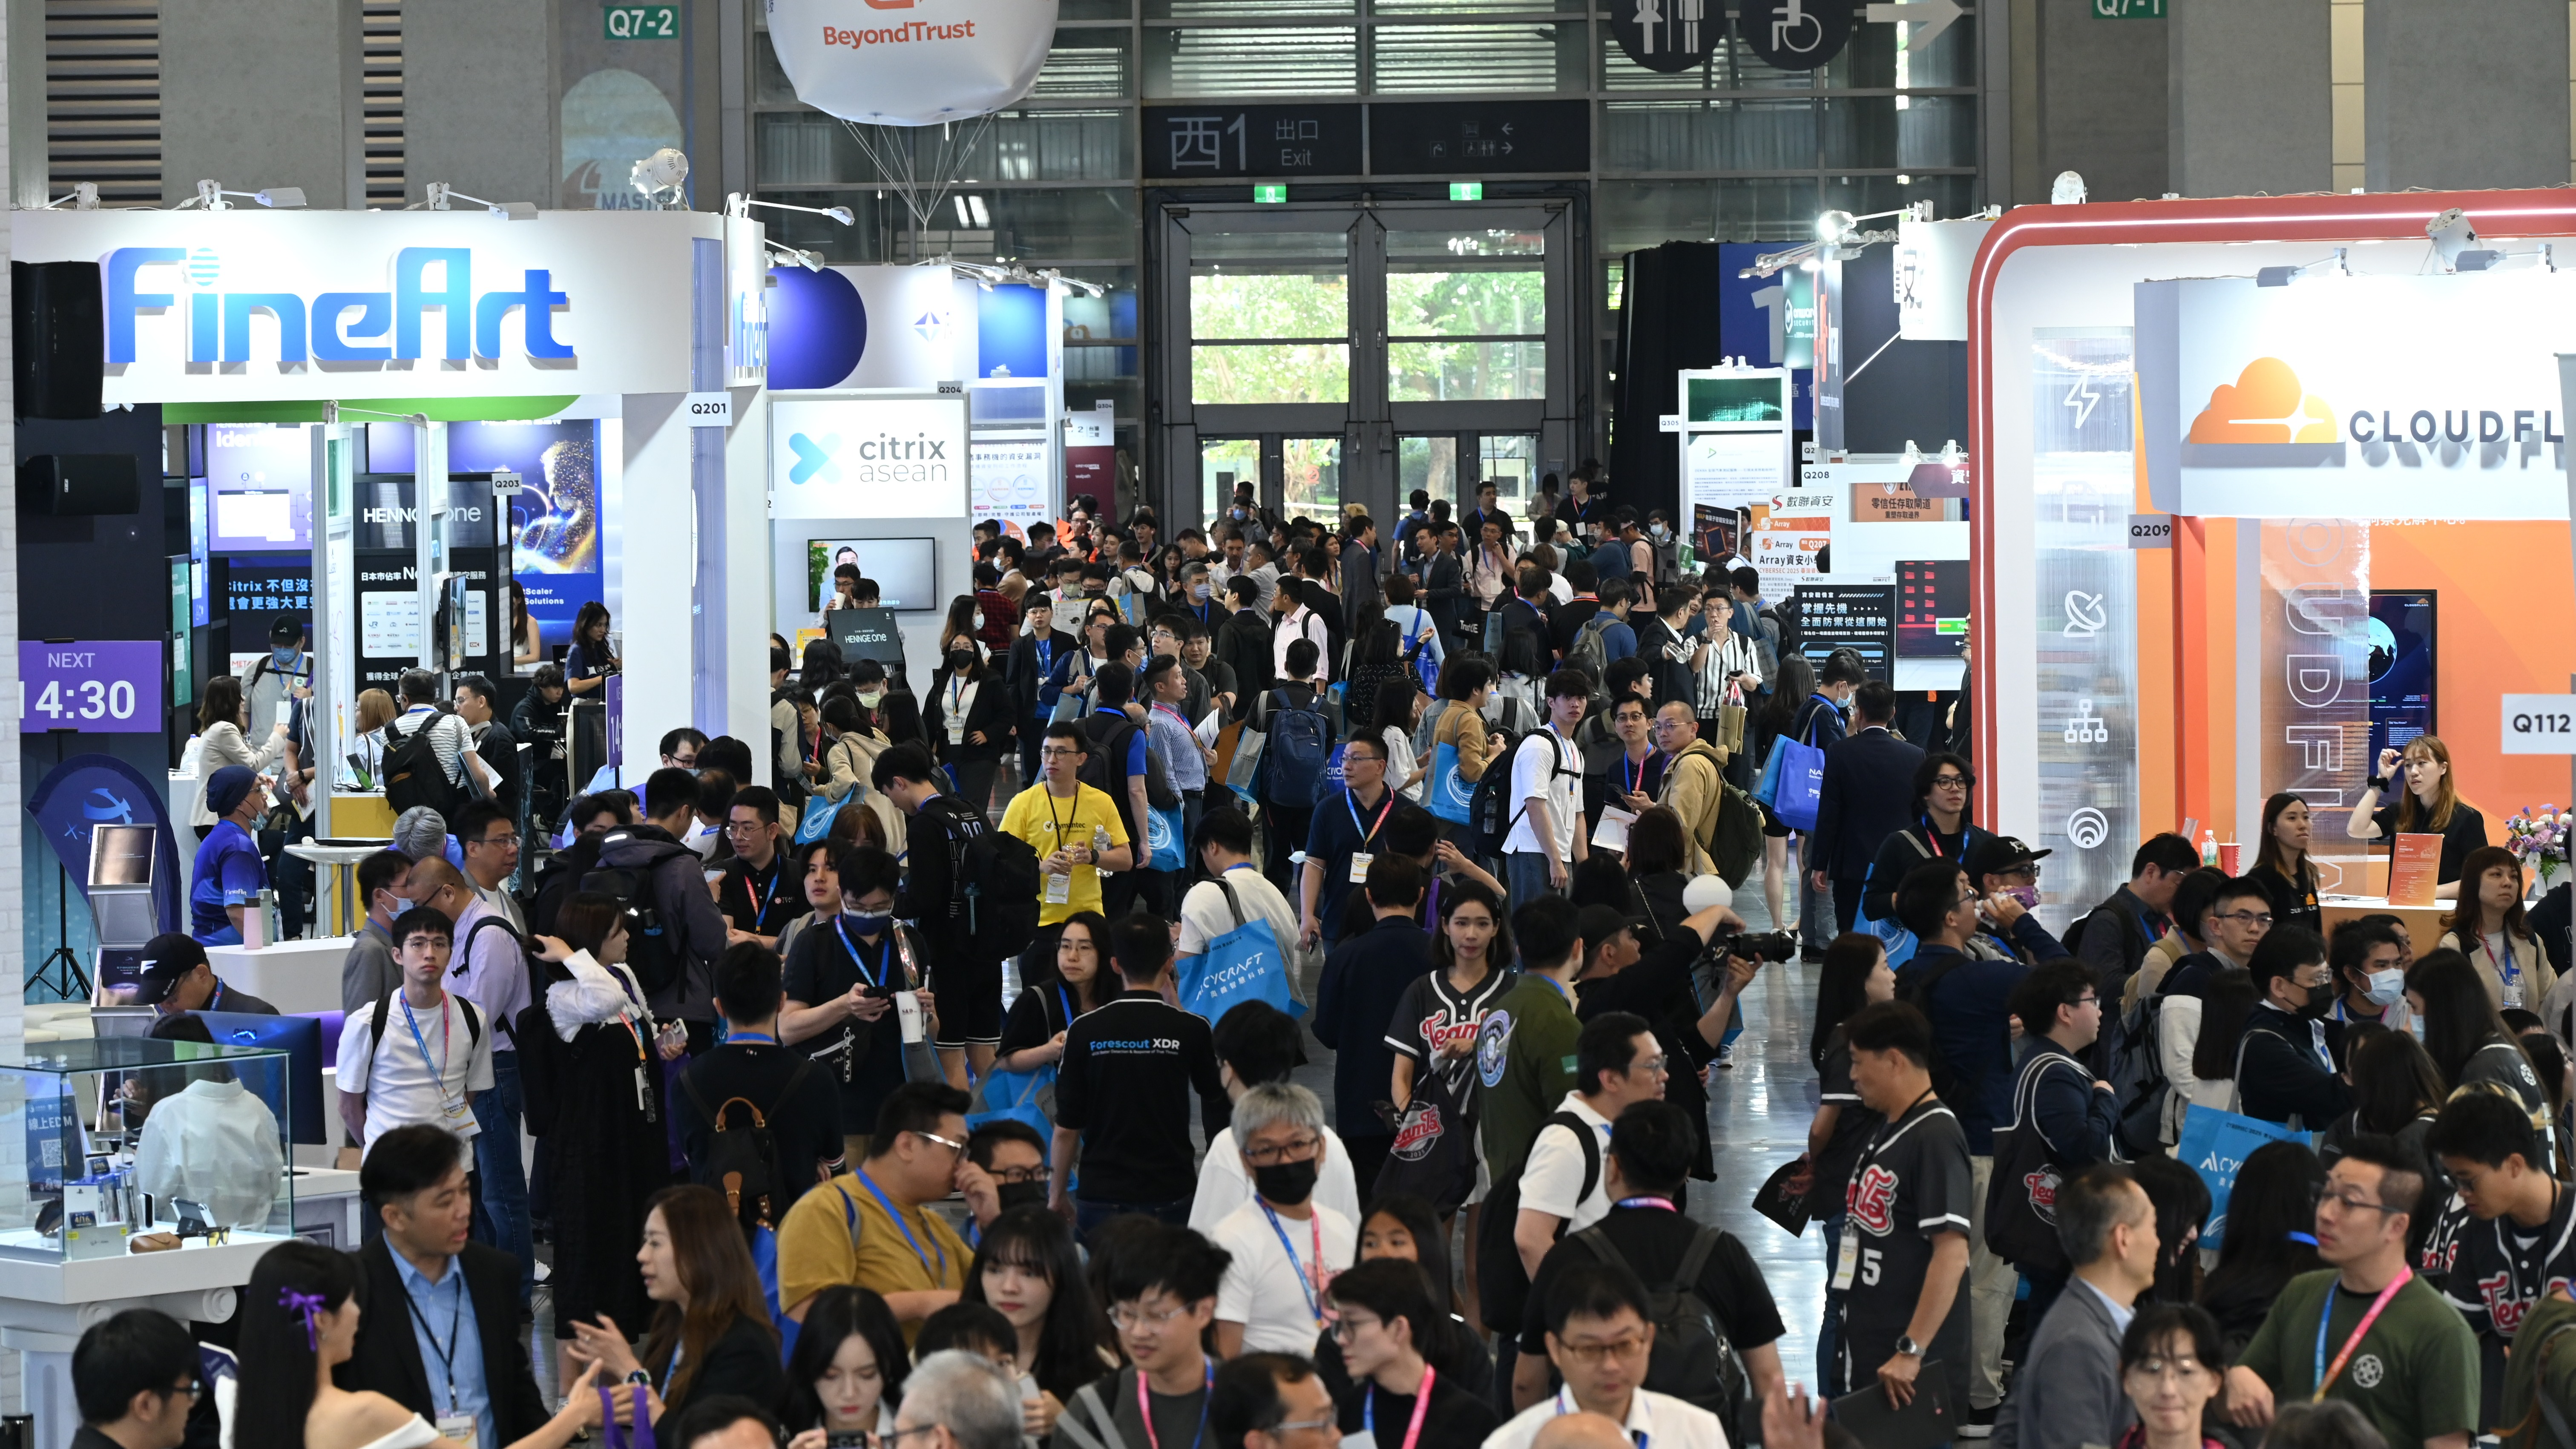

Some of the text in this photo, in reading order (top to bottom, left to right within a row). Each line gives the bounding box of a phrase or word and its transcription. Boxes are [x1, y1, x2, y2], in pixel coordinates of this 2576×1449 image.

[609, 10, 673, 37] Q7-2
[823, 20, 975, 49] BeyondTrust
[1276, 119, 1319, 141] 出口
[1282, 149, 1312, 167] Exit
[106, 247, 574, 364] FineArt
[939, 386, 961, 394] Q204
[691, 403, 727, 415] Q201
[860, 433, 946, 460] citrix
[860, 461, 947, 483] asean
[1951, 469, 1969, 484] 資
[495, 480, 520, 489] Q203
[1787, 495, 1833, 507] 數聯資安
[2131, 525, 2171, 538] Q209
[1809, 540, 1827, 549] Q207
[362, 572, 402, 581] 日本市佔率
[403, 566, 417, 580] N
[230, 579, 313, 592] itrix 不但沒
[230, 597, 313, 610] 會更強大更
[524, 597, 564, 605] Solutions
[1802, 603, 1848, 614] 掌握先機
[1801, 617, 1887, 627] 全面防禦從這開始
[845, 634, 871, 644] HENNGE
[48, 653, 95, 668] NEXT
[366, 672, 399, 681] 獲得全球
[2513, 713, 2571, 733] Q112
[1090, 1038, 1180, 1052] Forescout XDR
[1392, 1105, 1444, 1151] eamT5
[2026, 1172, 2056, 1205] Tea
[1862, 1249, 1883, 1286] 5
